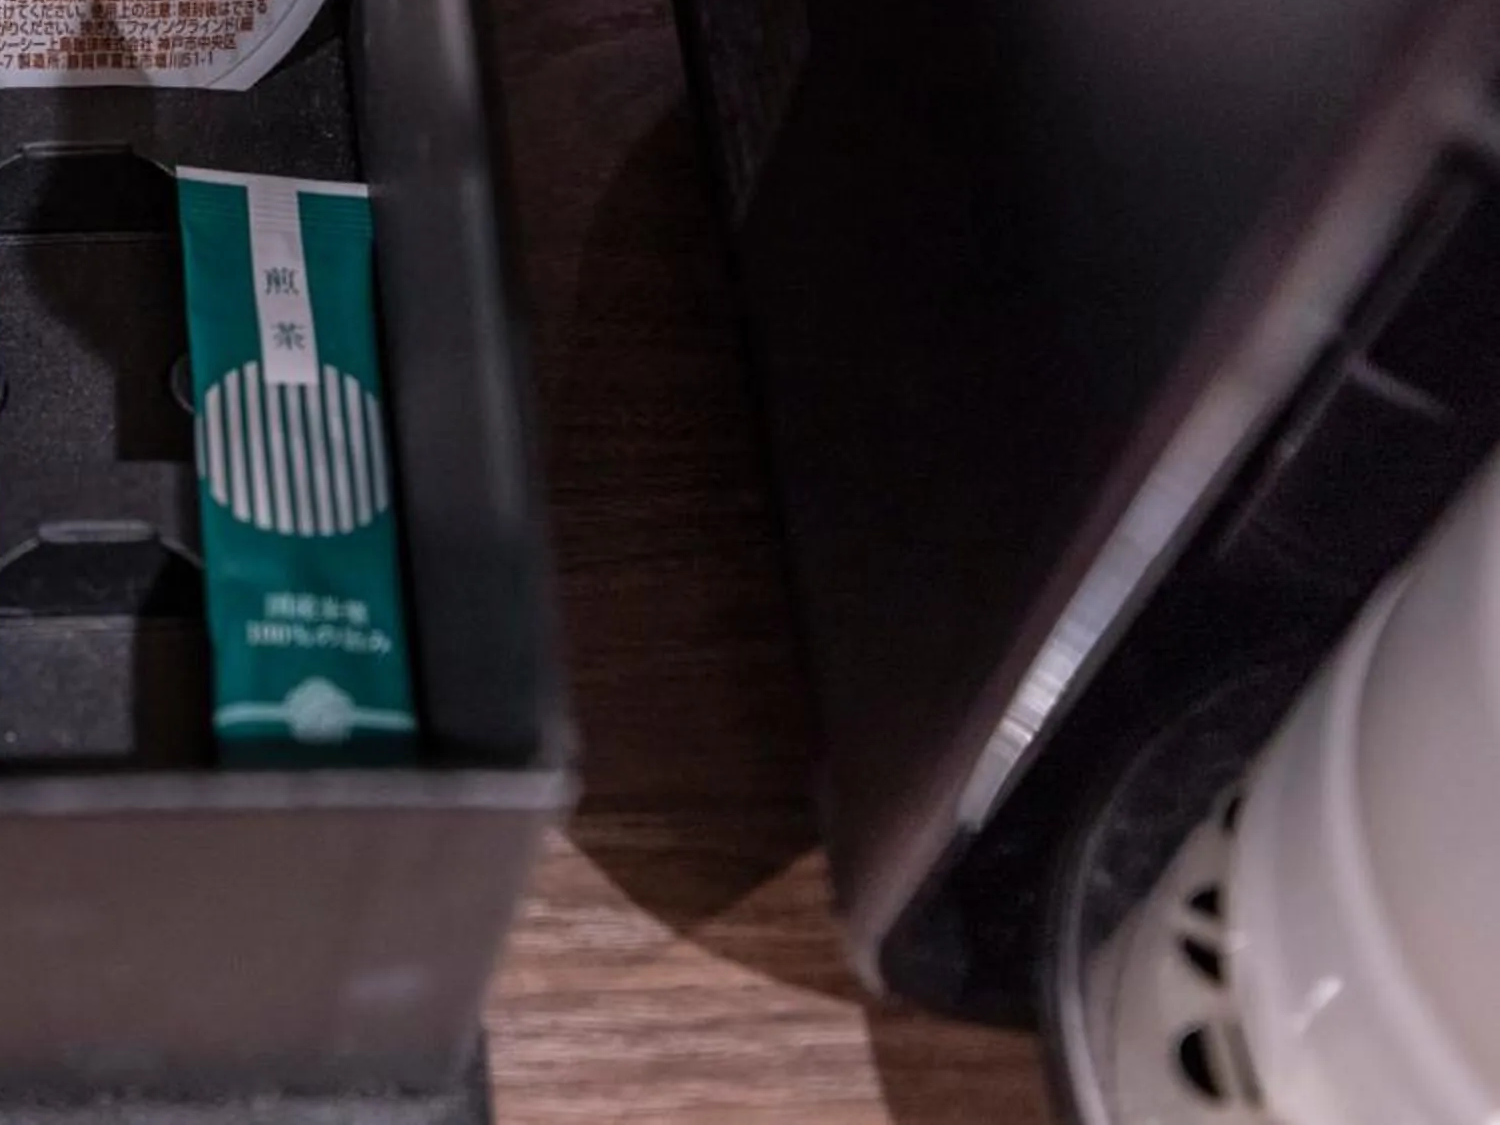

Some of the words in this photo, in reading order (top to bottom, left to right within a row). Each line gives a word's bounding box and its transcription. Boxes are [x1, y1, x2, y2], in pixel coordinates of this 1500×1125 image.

[158, 33, 237, 51] 神戸市中央区
